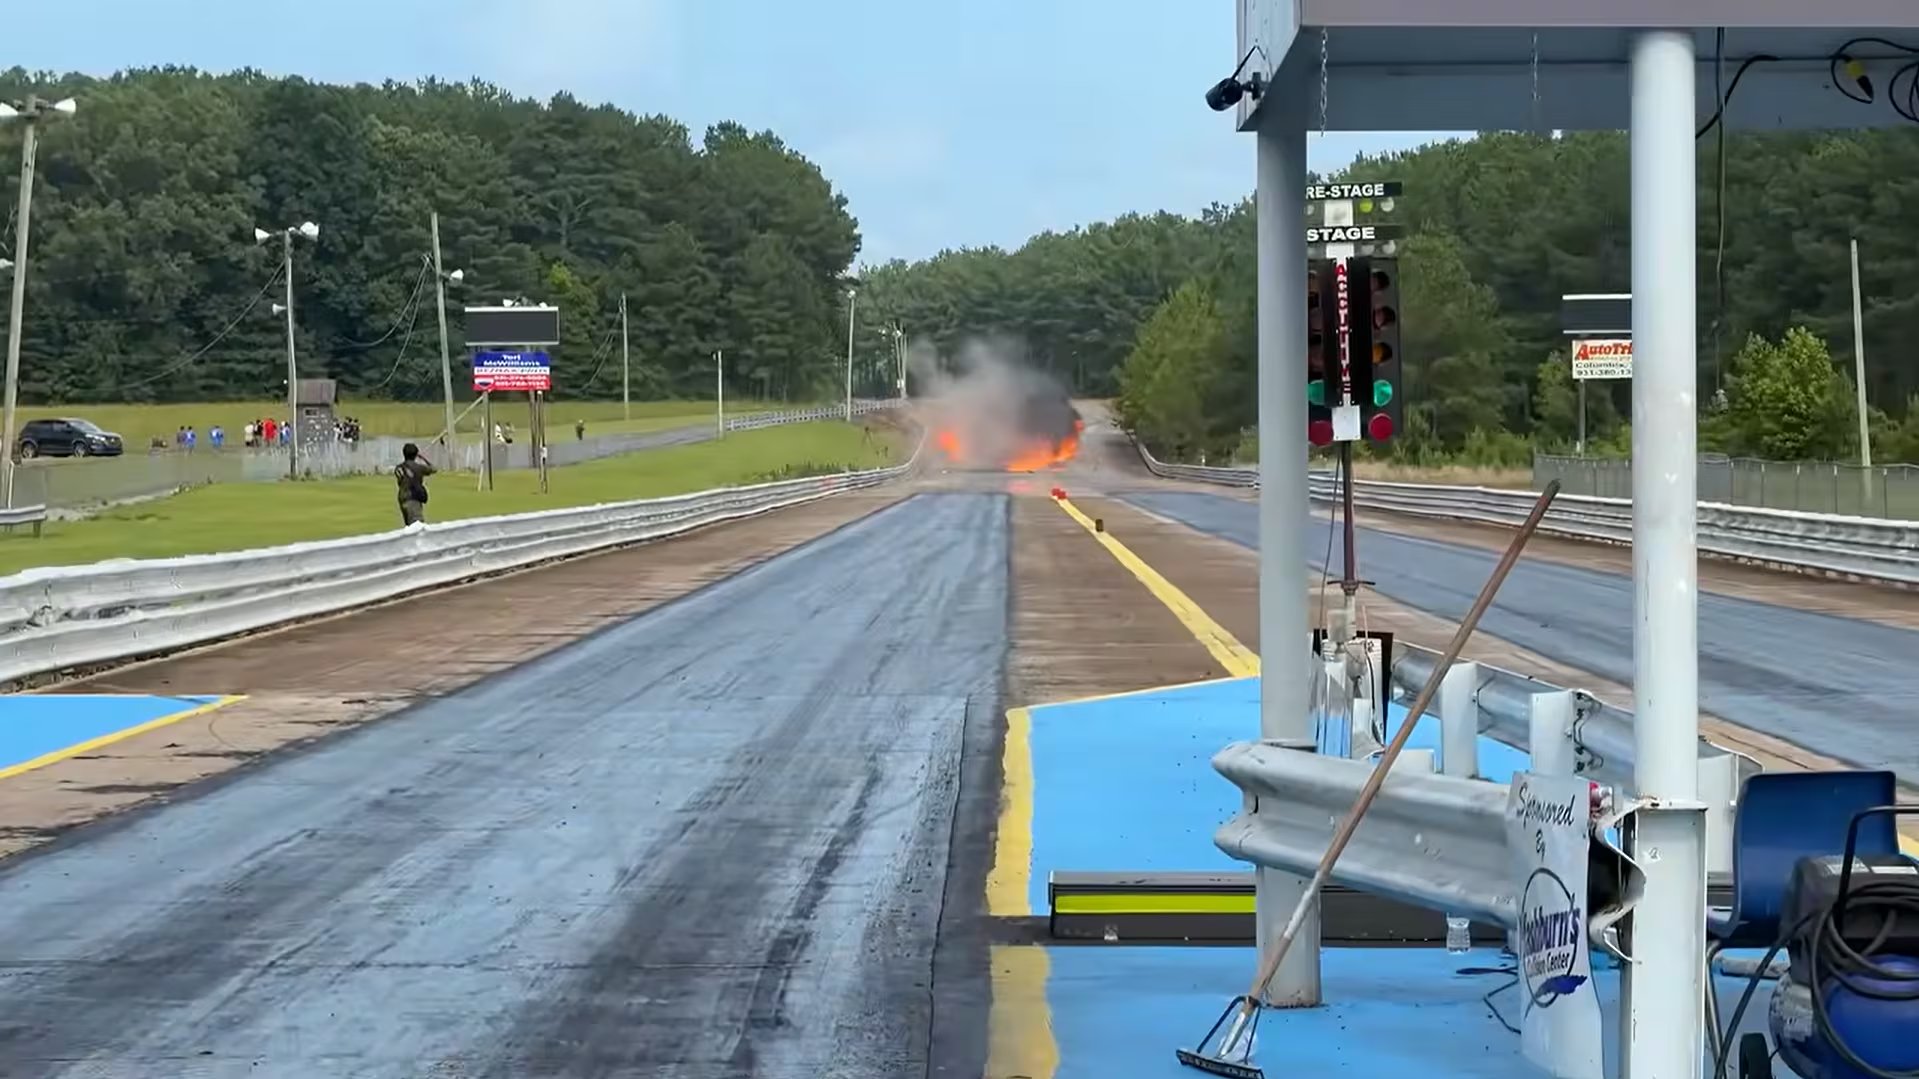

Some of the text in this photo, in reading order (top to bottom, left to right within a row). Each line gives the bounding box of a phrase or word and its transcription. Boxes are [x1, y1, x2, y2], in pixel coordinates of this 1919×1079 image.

[1306, 226, 1376, 242] STAGE
[1516, 782, 1576, 831] Sponsored
[1535, 828, 1546, 862] By
[1546, 951, 1570, 973] Center
